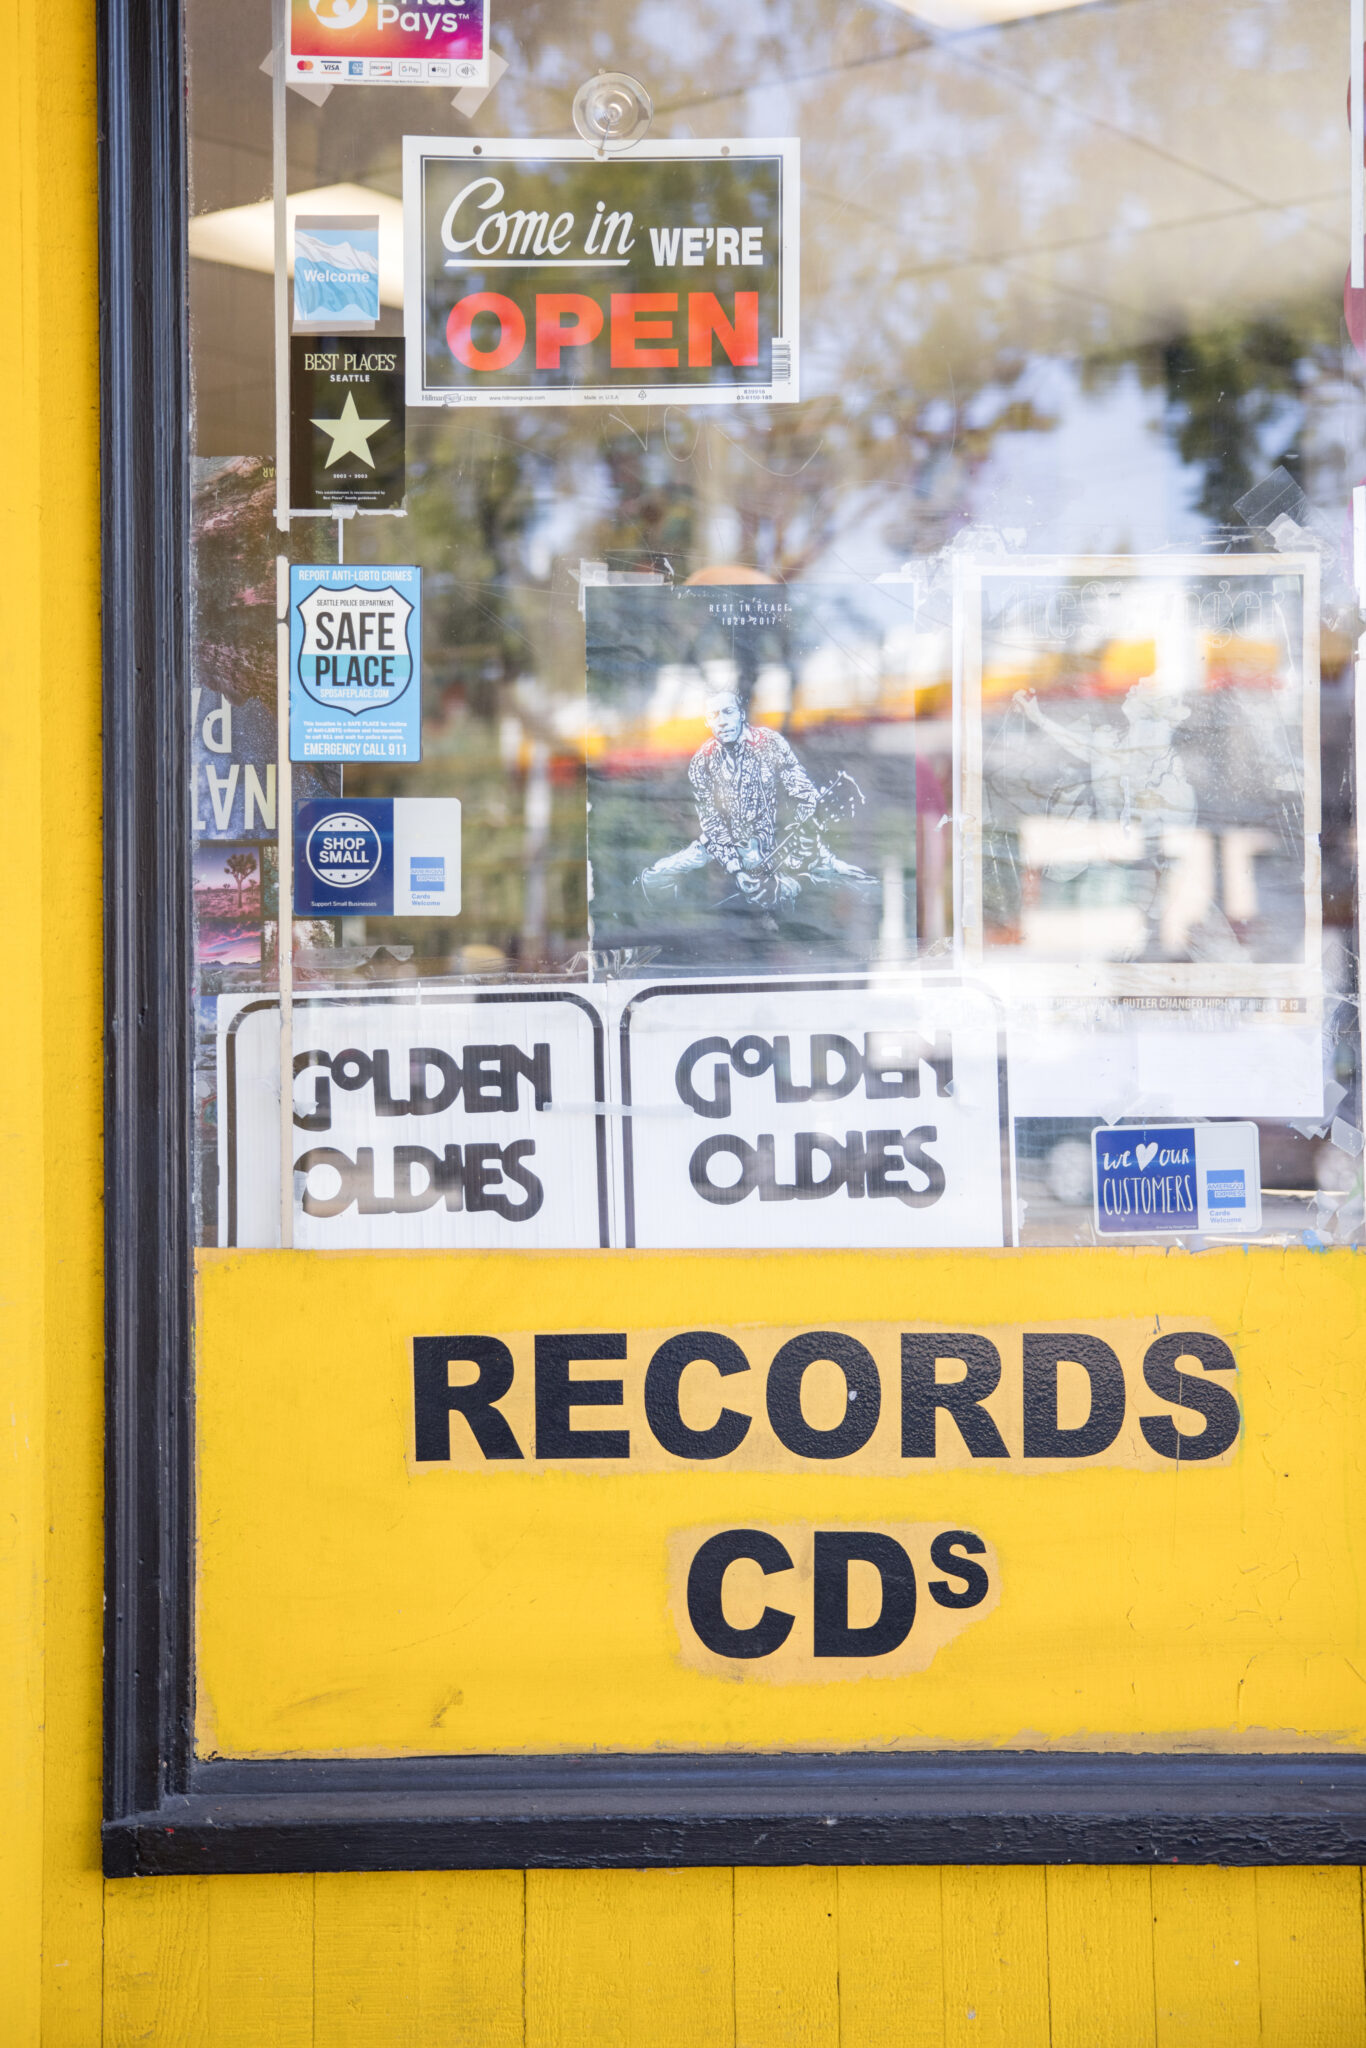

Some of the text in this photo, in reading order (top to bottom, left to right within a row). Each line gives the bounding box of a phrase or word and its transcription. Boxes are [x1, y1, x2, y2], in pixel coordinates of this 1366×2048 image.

[441, 177, 763, 267] Come in WE'RE
[304, 270, 370, 283] Welcome
[446, 291, 759, 371] OPEN
[304, 354, 339, 371] BEST
[330, 374, 370, 382] SEATTLE
[299, 570, 413, 582] REPORT ANTI-LGBTQ CRIMES
[709, 603, 789, 612] REST IN PEACE
[316, 611, 396, 651] SAFE
[315, 656, 396, 687] PLACE
[304, 743, 408, 756] EMERGENCY CALL 911
[323, 837, 366, 851] SHOP
[319, 850, 370, 864] SMALL
[1159, 998, 1202, 1010] CHANGED
[675, 1030, 953, 1119] GOLDEN
[293, 1043, 552, 1132] GOLDEN
[689, 1125, 946, 1208] OLDIES
[294, 1139, 544, 1222] OLDIES
[1207, 1182, 1244, 1191] AMERICAN
[1103, 1175, 1194, 1216] CUSTOMERS
[413, 1331, 1242, 1461] RECORDS
